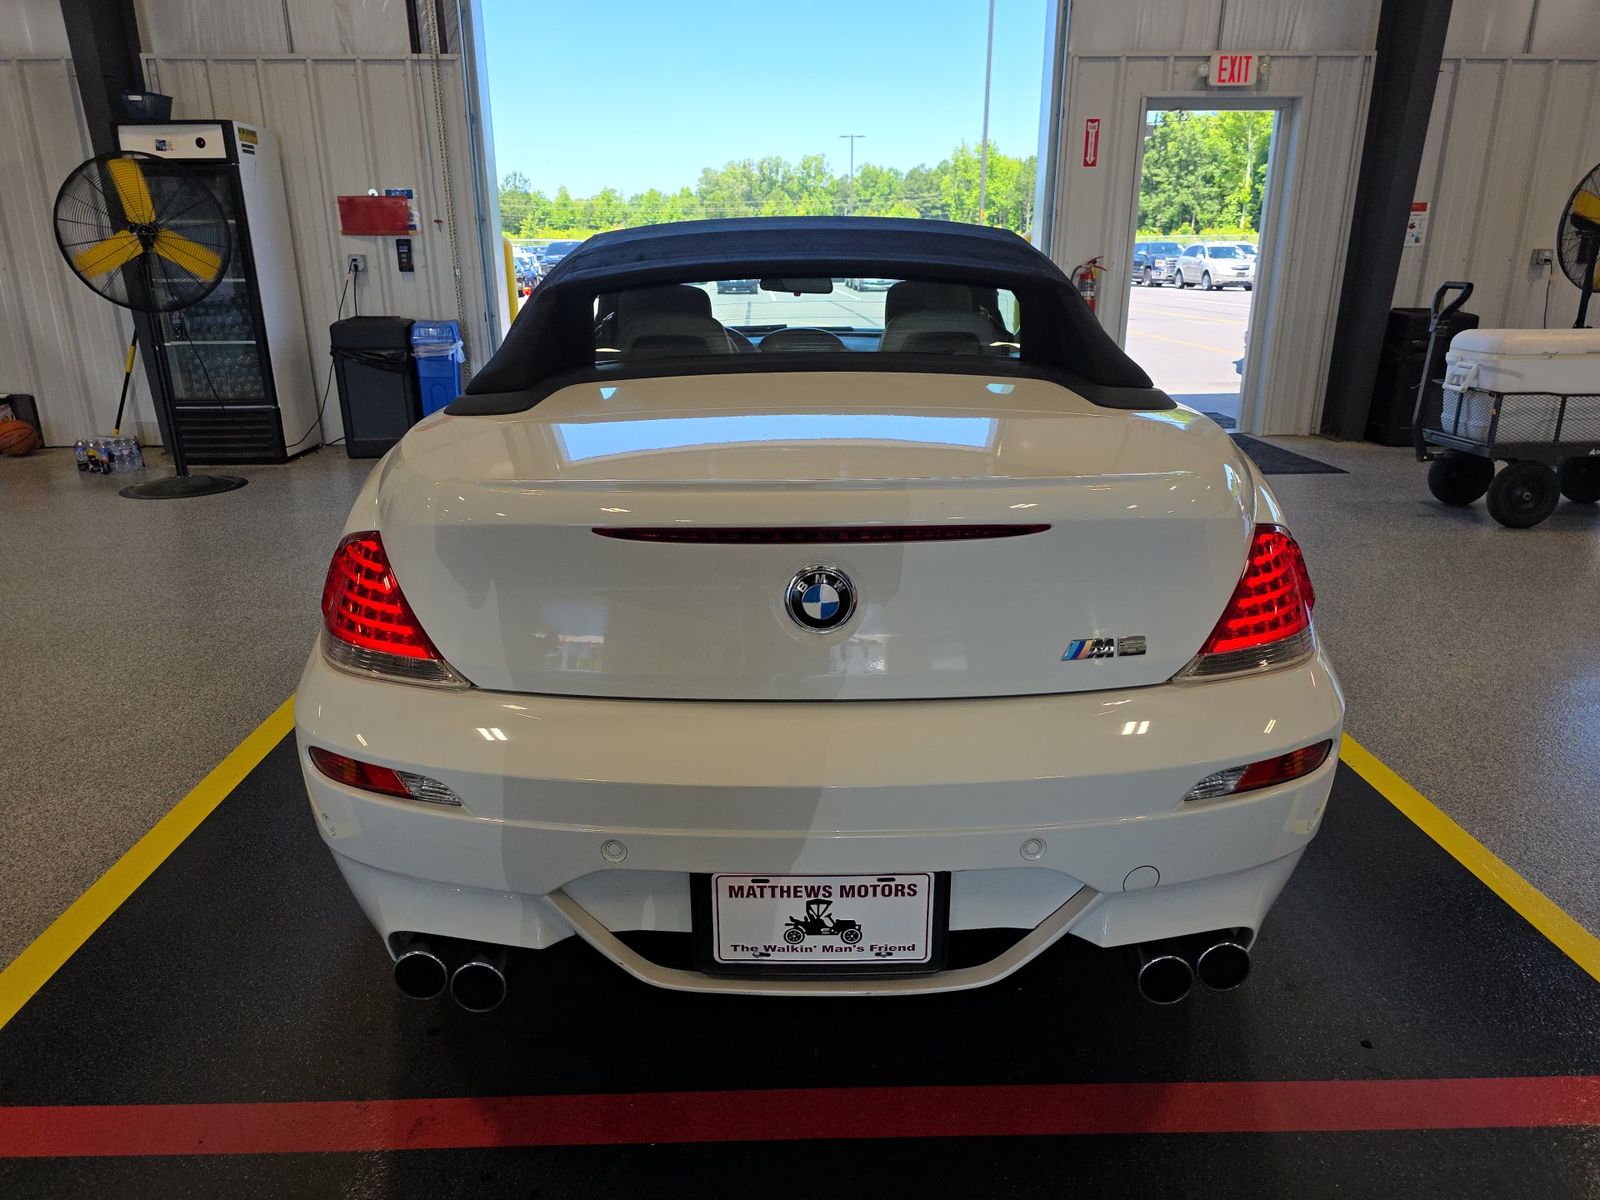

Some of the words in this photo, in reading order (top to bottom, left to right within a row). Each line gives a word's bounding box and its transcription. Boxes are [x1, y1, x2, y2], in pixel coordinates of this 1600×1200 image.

[1217, 55, 1253, 83] EXIT
[796, 573, 846, 593] BMW
[728, 884, 833, 899] MATTHEWS
[839, 883, 918, 898] MOTORS
[730, 944, 759, 952] The
[763, 944, 817, 953] Walkin'
[822, 944, 865, 953] Man's
[869, 943, 916, 952] Friend
